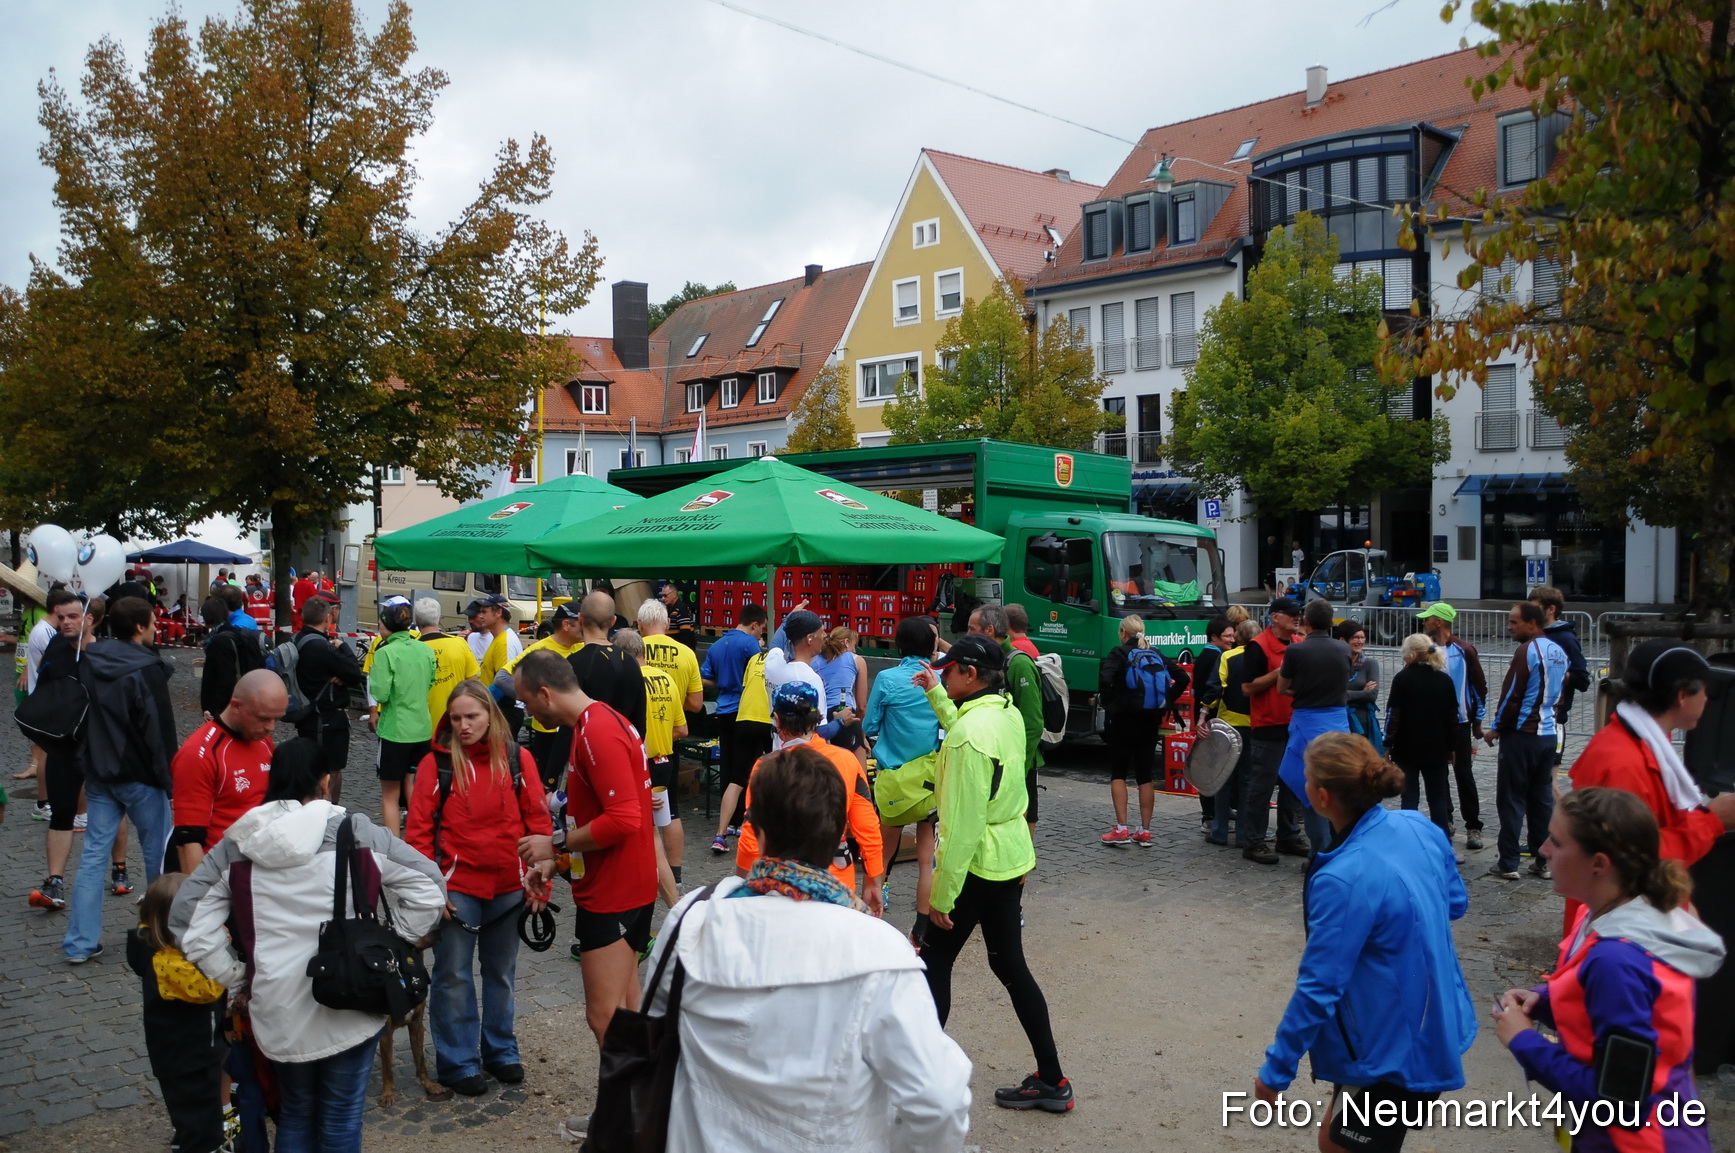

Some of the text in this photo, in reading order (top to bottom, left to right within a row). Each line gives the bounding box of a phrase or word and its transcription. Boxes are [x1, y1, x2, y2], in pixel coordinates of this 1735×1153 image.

[1208, 502, 1217, 516] P
[1439, 504, 1446, 516] 3
[607, 521, 722, 535] Lammsbräu
[387, 574, 406, 584] Kreuz
[1144, 632, 1186, 645] eumarkter
[646, 643, 679, 662] MTP
[646, 661, 679, 670] Hersbruck
[1340, 1127, 1372, 1144] saller
